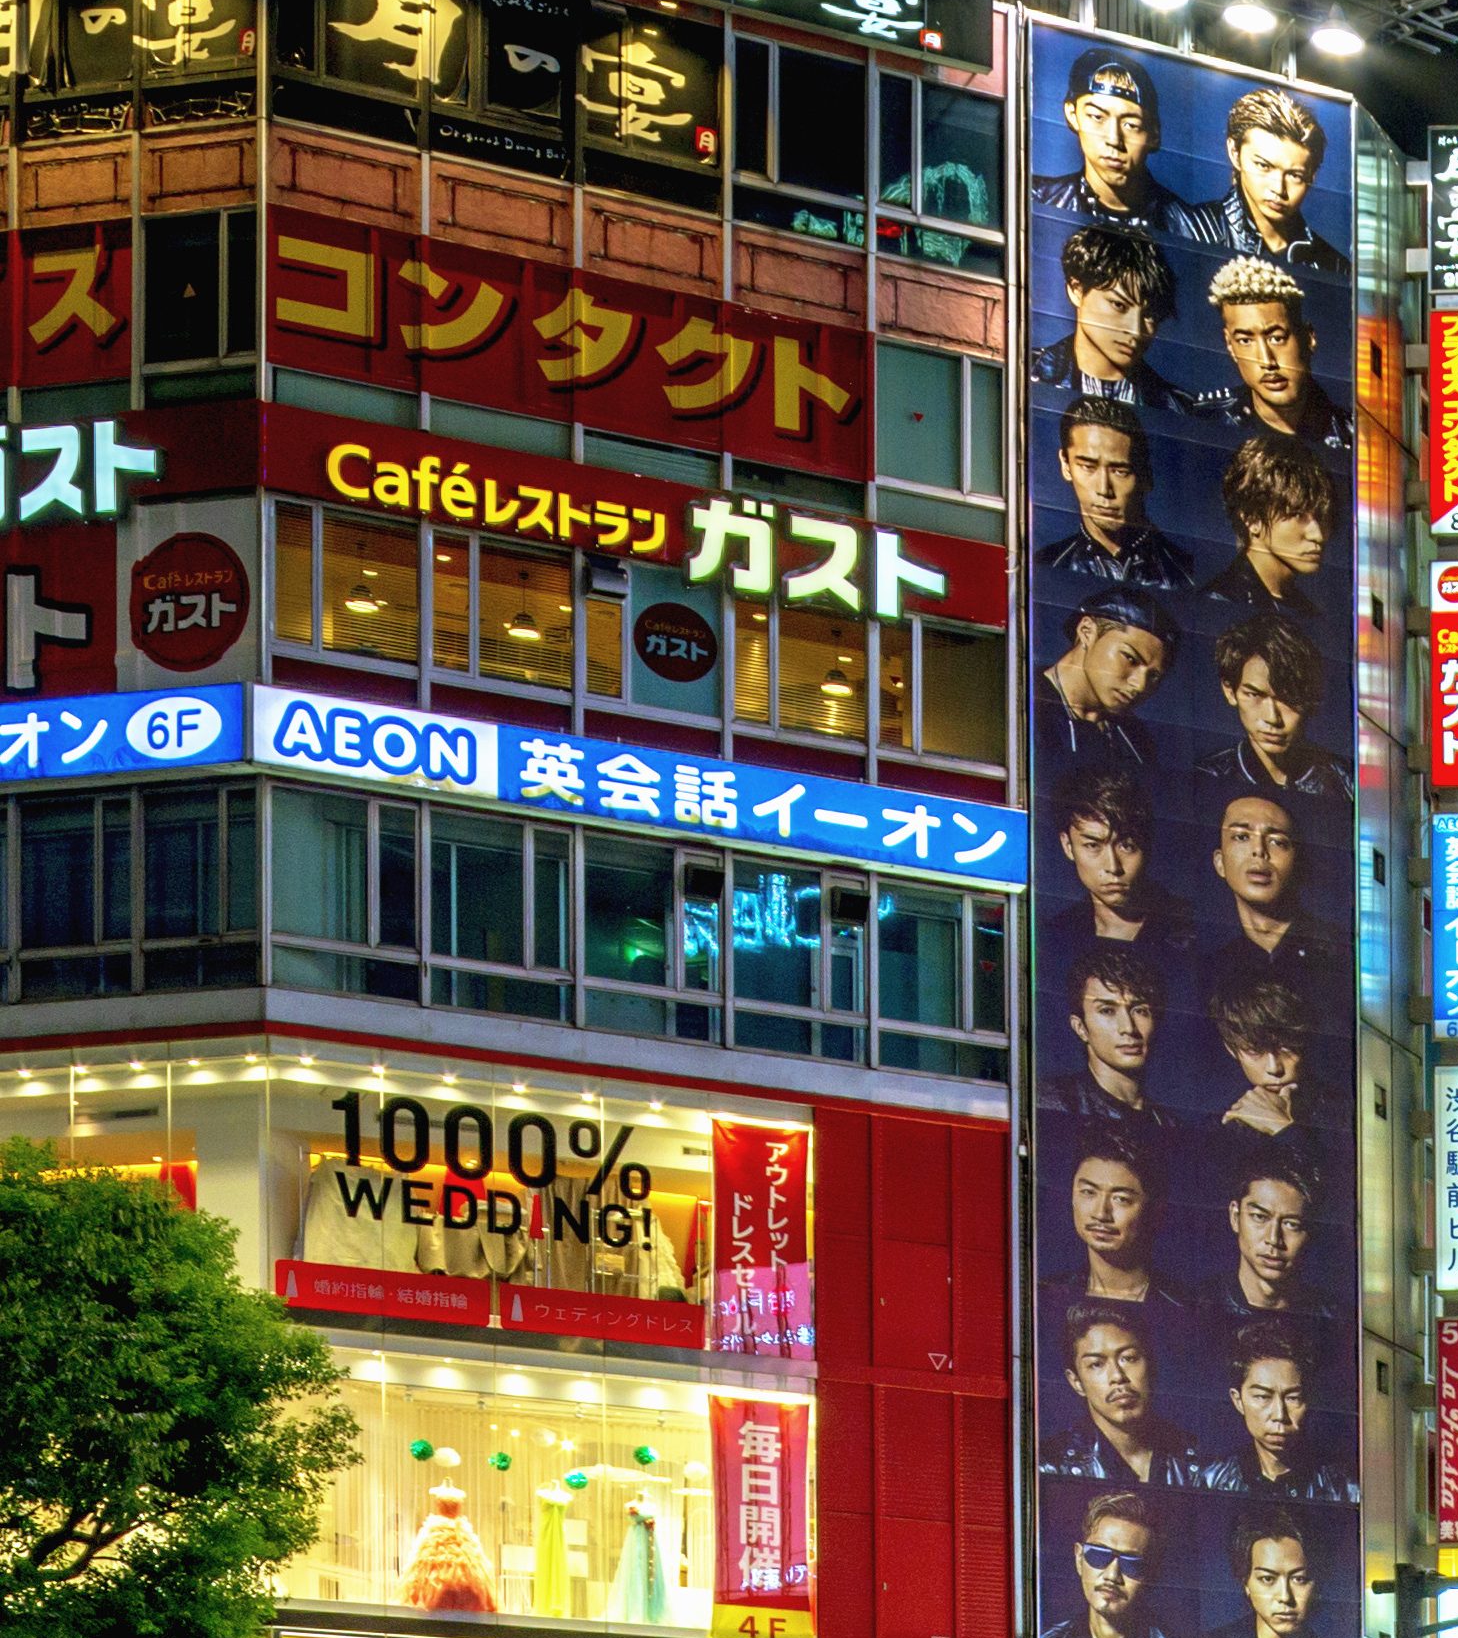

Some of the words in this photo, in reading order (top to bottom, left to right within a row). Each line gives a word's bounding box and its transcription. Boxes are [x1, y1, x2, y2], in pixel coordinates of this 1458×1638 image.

[275, 236, 851, 431] コンタクト
[147, 592, 237, 634] ガスト
[687, 497, 948, 619] ガスト
[7, 574, 87, 689] ト
[646, 634, 709, 662] ガスト
[148, 705, 202, 750] 6F
[277, 701, 477, 783] AEON
[330, 1090, 653, 1203] 1000%
[731, 1192, 755, 1334] ドレスセール
[766, 1141, 789, 1272] アウトレット
[314, 1276, 468, 1313] 婚約指輪・結婚指輪
[534, 1301, 693, 1337] ウェディングドレス
[738, 1420, 781, 1591] 毎日開催
